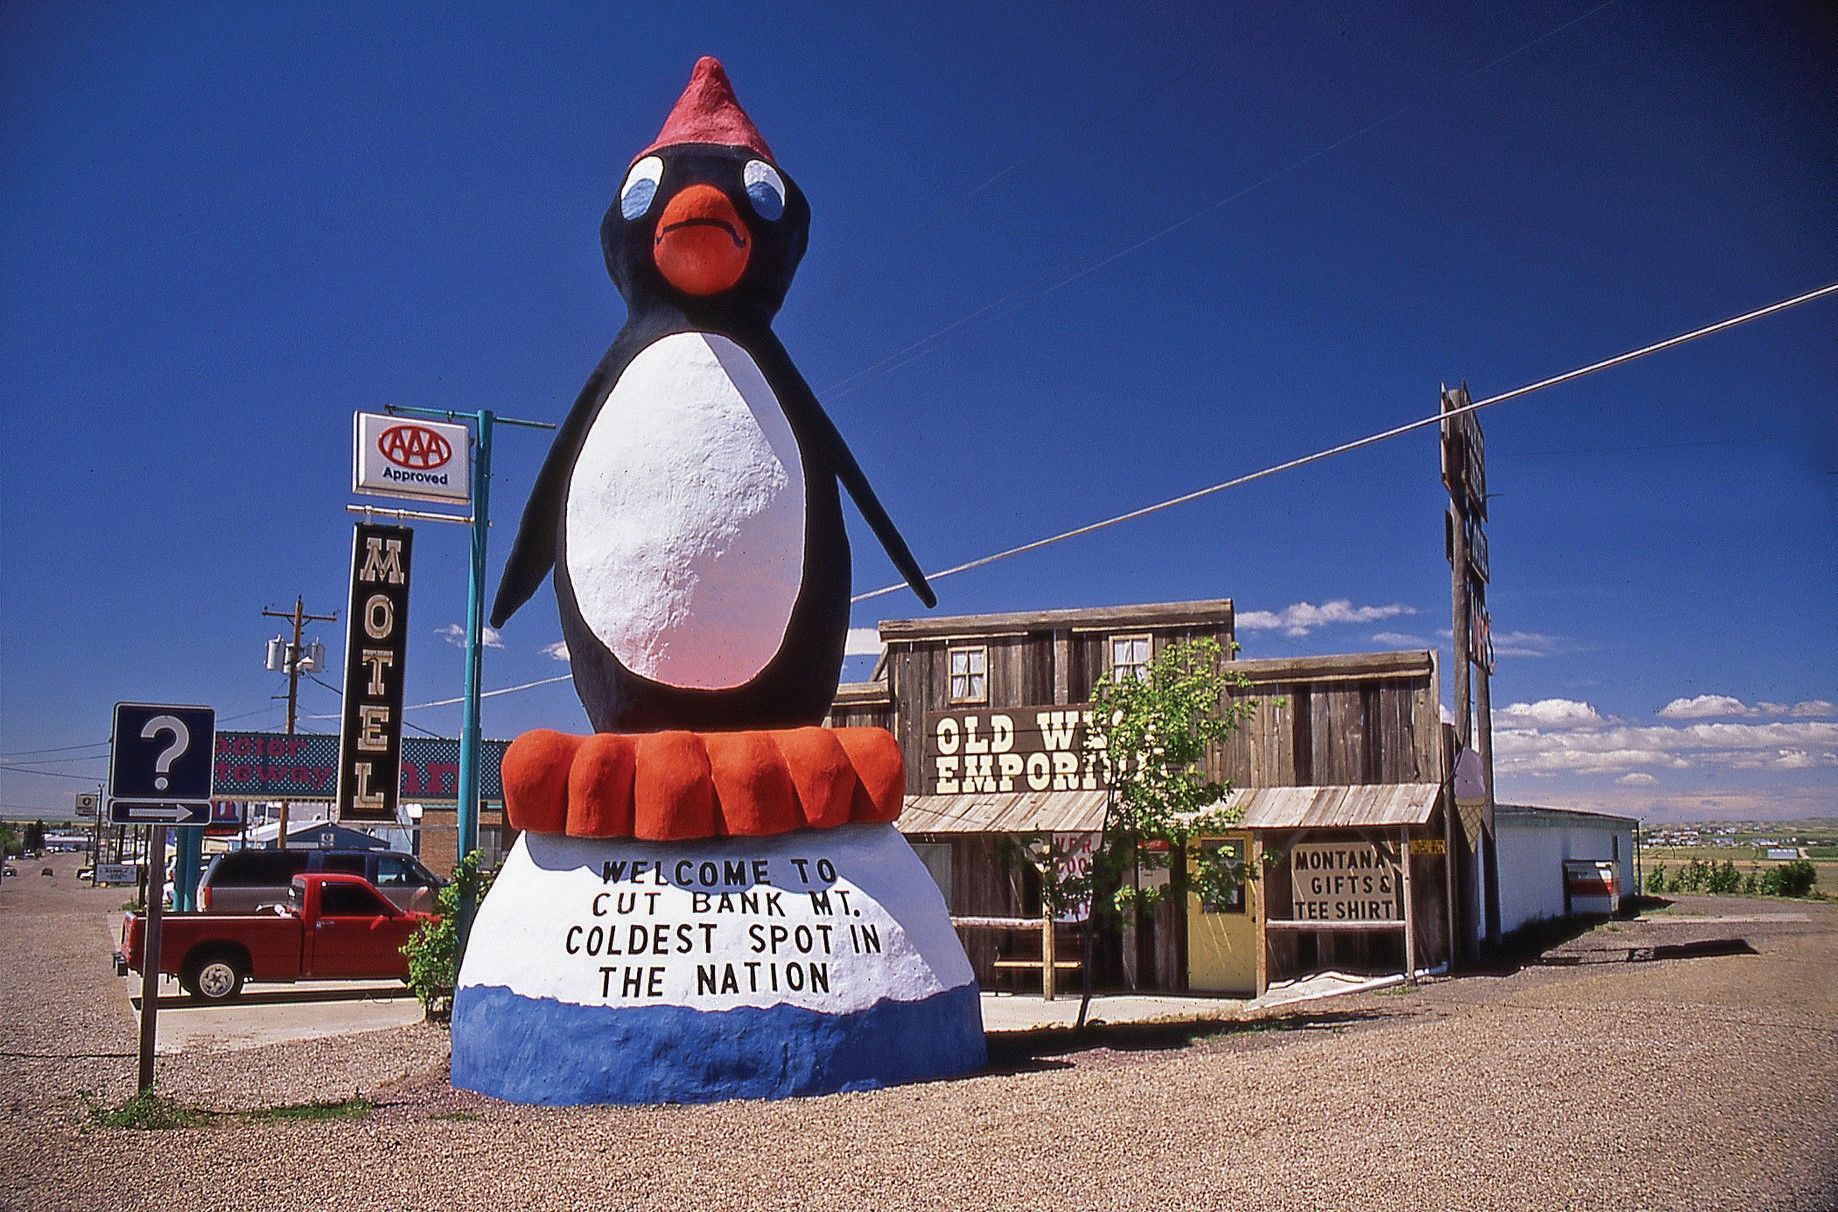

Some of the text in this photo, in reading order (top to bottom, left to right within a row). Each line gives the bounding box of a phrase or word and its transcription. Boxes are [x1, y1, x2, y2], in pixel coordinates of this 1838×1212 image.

[384, 428, 447, 465] AAA
[383, 466, 448, 485] Approved
[354, 537, 404, 809] MOTEL
[936, 715, 1015, 755] OLD
[602, 858, 837, 887] WELCOME TO
[1295, 851, 1386, 870] MONTANA
[593, 889, 861, 918] CUT BANK MT.
[1295, 901, 1393, 920] TEE SHIRT
[566, 923, 881, 955] COLDEST SPOT IN
[599, 961, 829, 998] THE NATION
